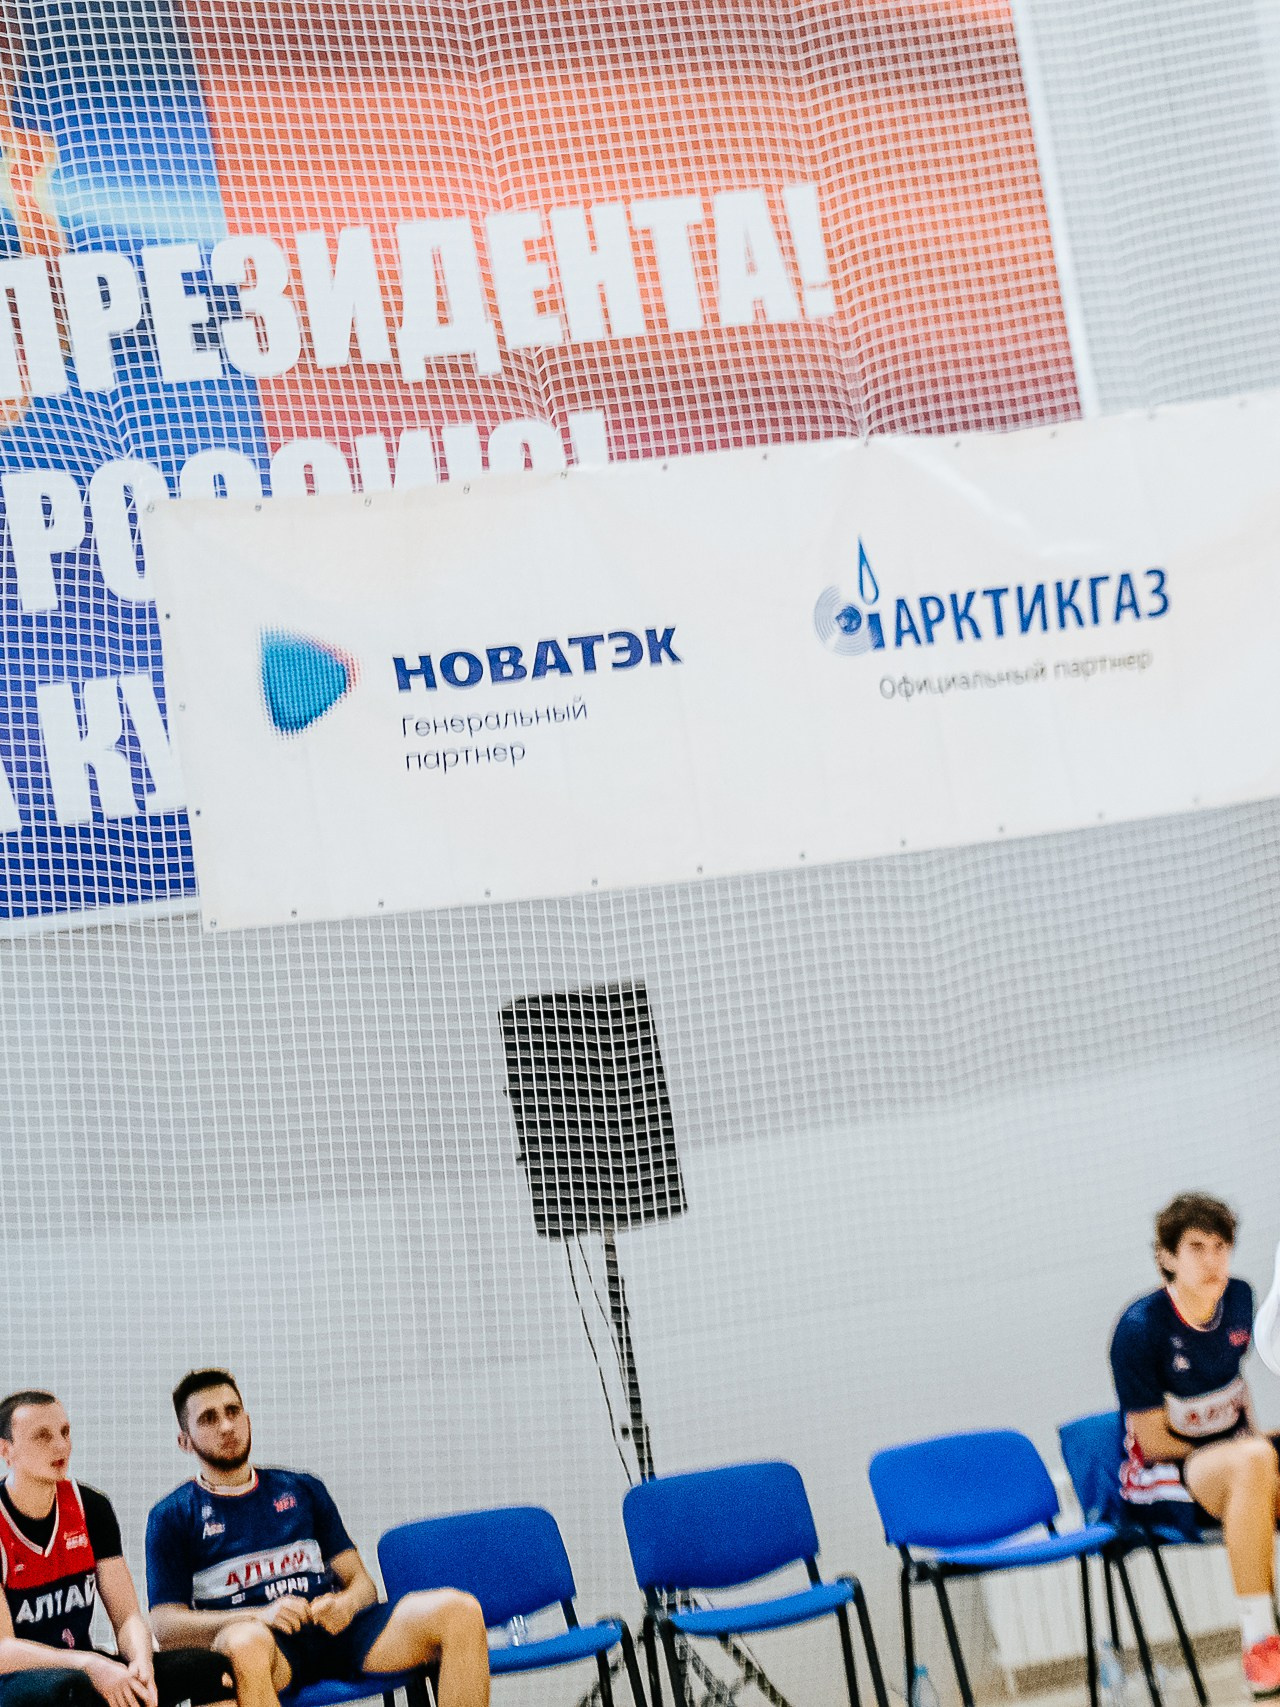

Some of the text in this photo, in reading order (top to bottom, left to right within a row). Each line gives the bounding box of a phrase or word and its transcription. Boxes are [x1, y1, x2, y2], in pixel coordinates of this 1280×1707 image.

[0, 183, 838, 400] ПРЕЗИДЕНТА!
[892, 566, 1171, 650] АРКТИКГАЗ
[392, 625, 684, 693] НОВАТЭК
[879, 648, 1154, 701] Официальный партнер
[402, 695, 588, 738] Генеральный
[405, 740, 526, 774] партнер
